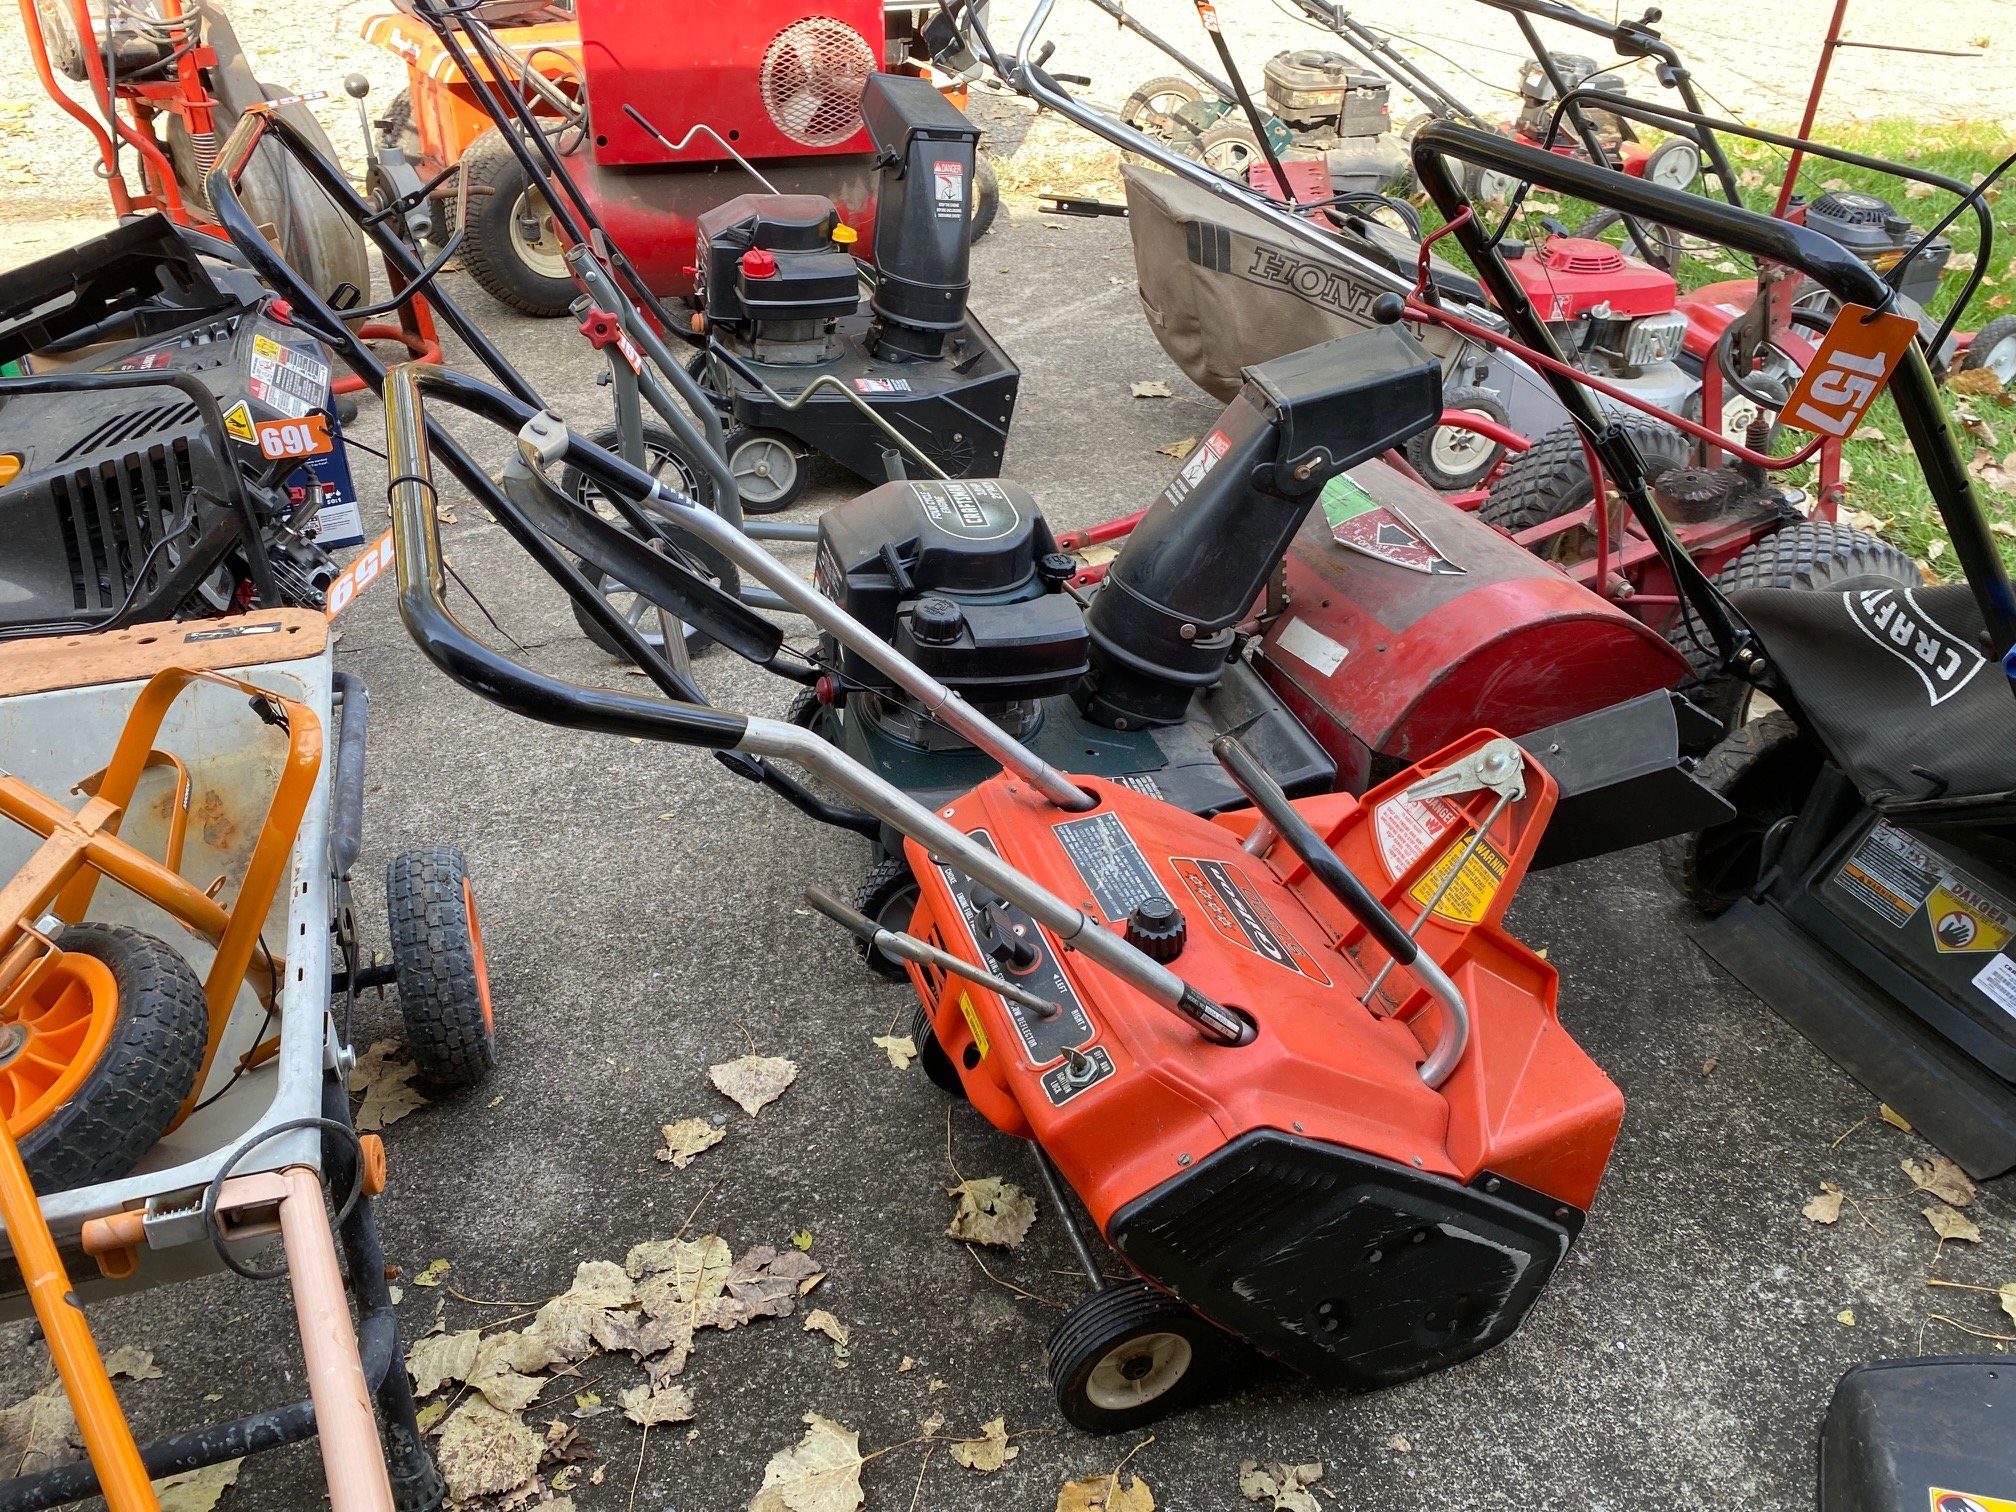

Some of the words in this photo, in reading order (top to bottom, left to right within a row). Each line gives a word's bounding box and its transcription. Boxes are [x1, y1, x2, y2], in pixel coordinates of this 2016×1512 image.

[268, 91, 325, 107] 158
[1796, 350, 1886, 436] 157
[261, 424, 318, 456] 169
[945, 484, 982, 524] CRAFTSMAN
[330, 535, 394, 614] 159
[1474, 841, 1508, 877] WARNIN
[943, 867, 958, 885] CHOKE
[1865, 878, 1899, 904] WARNING
[955, 891, 969, 909] ENGINE
[963, 907, 974, 920] FUEL
[1209, 866, 1282, 960] Gilson
[1950, 882, 2010, 926] DANGER
[1053, 978, 1067, 994] LEFT
[1015, 1015, 1038, 1048] DEFLECTOR
[1069, 1008, 1085, 1026] RIGHT
[1049, 1079, 1062, 1094] LOCK
[1055, 1071, 1072, 1093] IGNITION
